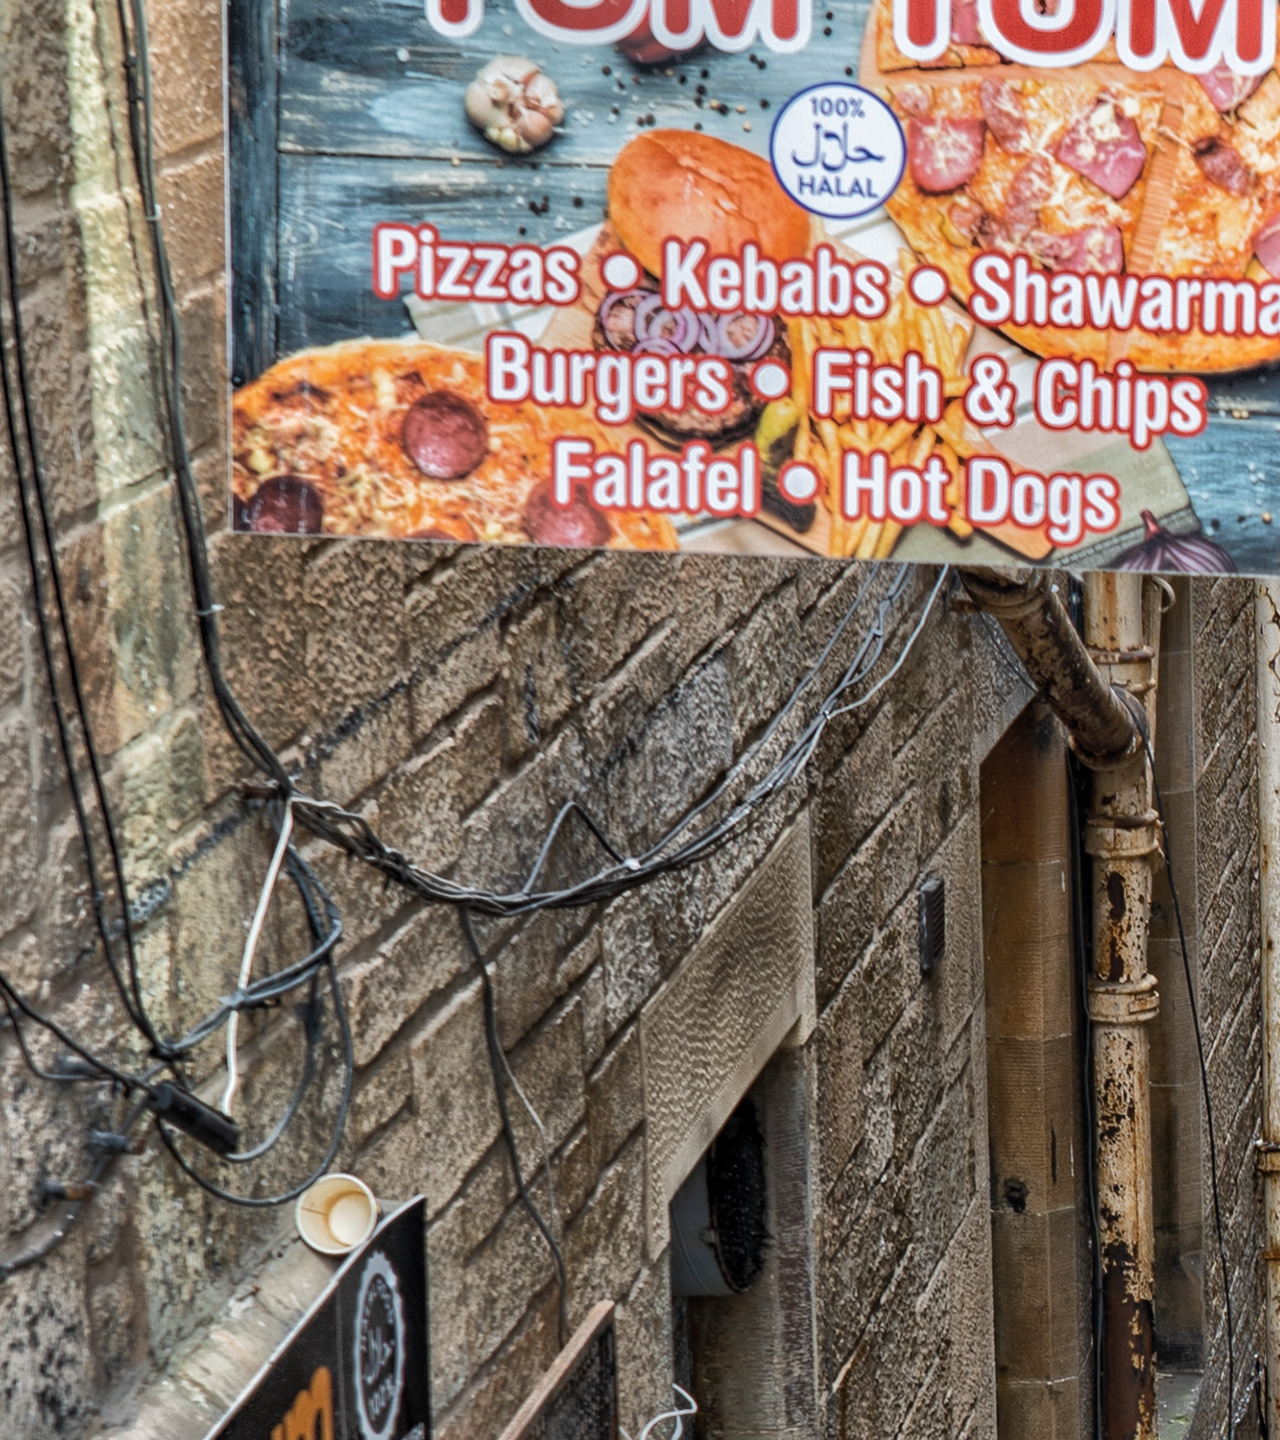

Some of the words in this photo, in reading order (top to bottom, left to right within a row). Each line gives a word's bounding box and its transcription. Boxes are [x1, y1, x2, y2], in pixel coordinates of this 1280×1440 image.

[810, 96, 865, 118] 100%
[790, 120, 886, 174] حلال
[797, 173, 879, 199] HALAL
[374, 223, 580, 304] Pizzas
[662, 238, 888, 322] Kebabs
[487, 331, 731, 426] Burgers
[812, 351, 942, 424] Fish
[965, 364, 1014, 426] &
[1035, 363, 1207, 448] Chips
[551, 436, 758, 517] Falafel
[842, 450, 951, 526] Hot
[965, 459, 1121, 547] Dogs
